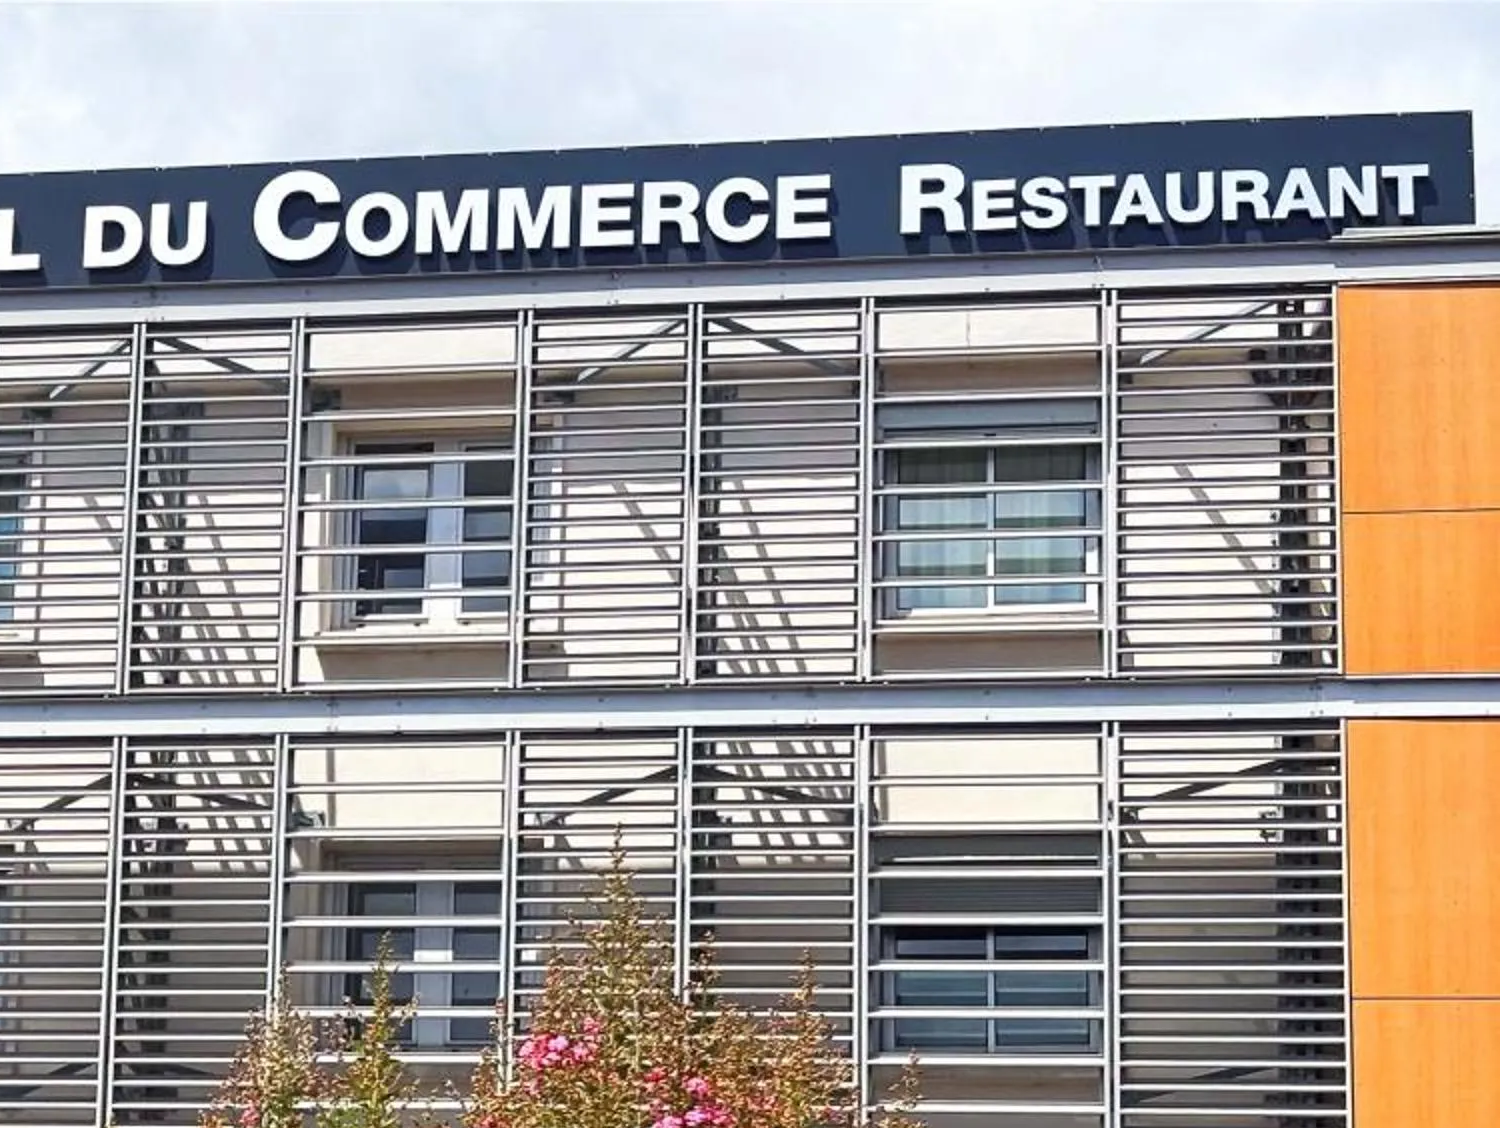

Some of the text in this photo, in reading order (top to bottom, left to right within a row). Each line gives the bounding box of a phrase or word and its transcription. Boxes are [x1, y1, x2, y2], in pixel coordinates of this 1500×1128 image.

[83, 201, 208, 268] DU
[253, 170, 831, 261] COMMERCE
[900, 163, 1430, 233] RESTAURANT
